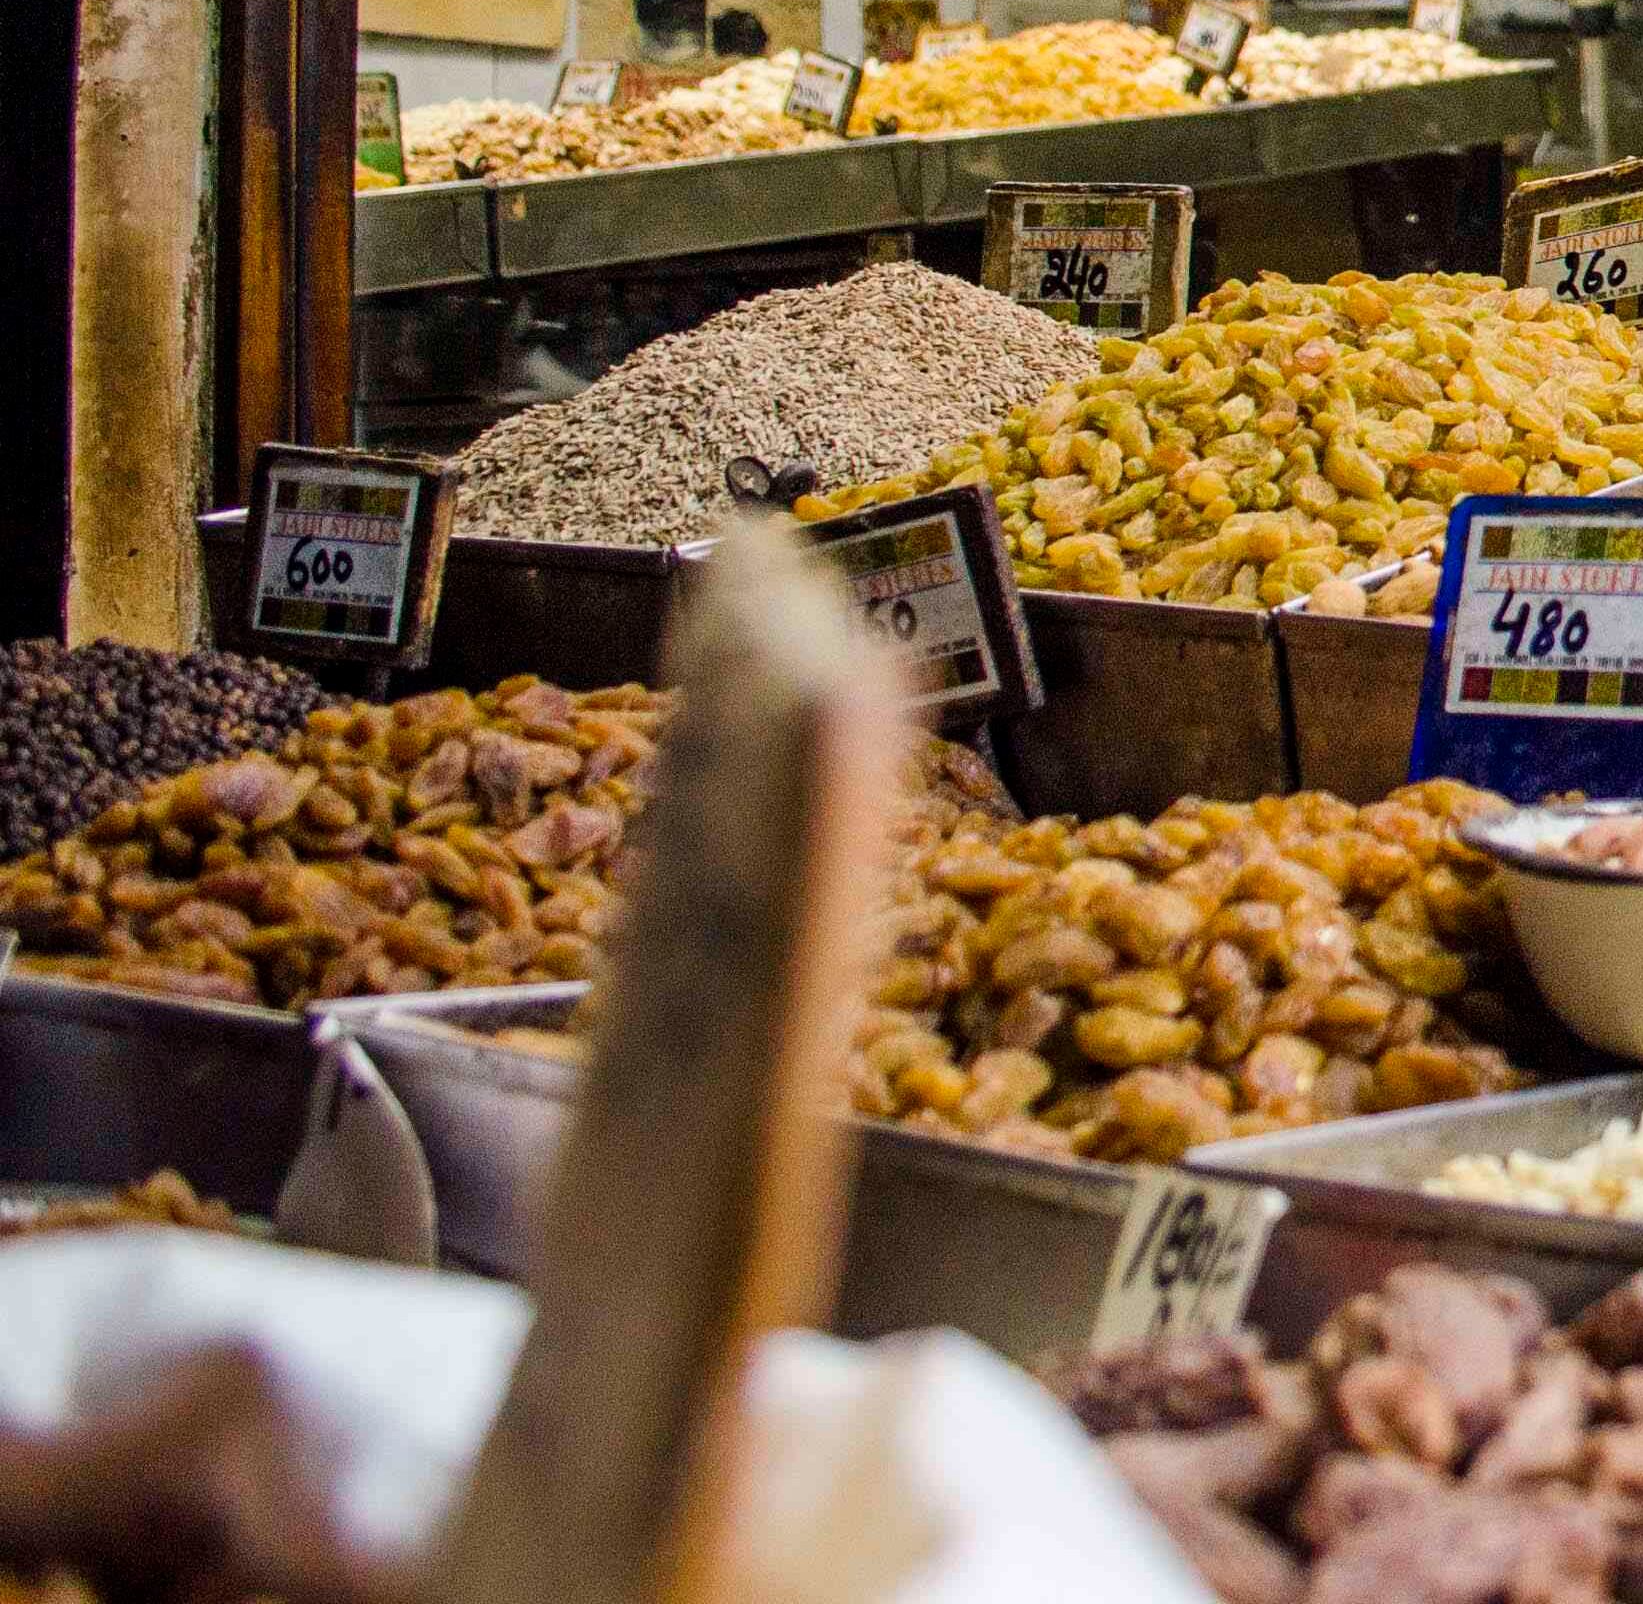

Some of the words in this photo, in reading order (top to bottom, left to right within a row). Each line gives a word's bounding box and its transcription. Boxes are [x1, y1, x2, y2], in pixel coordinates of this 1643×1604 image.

[1040, 244, 1109, 305] 240
[1556, 249, 1628, 300] 260
[286, 532, 354, 591] 600
[1484, 563, 1550, 592] JAIN
[1490, 587, 1590, 658] 480
